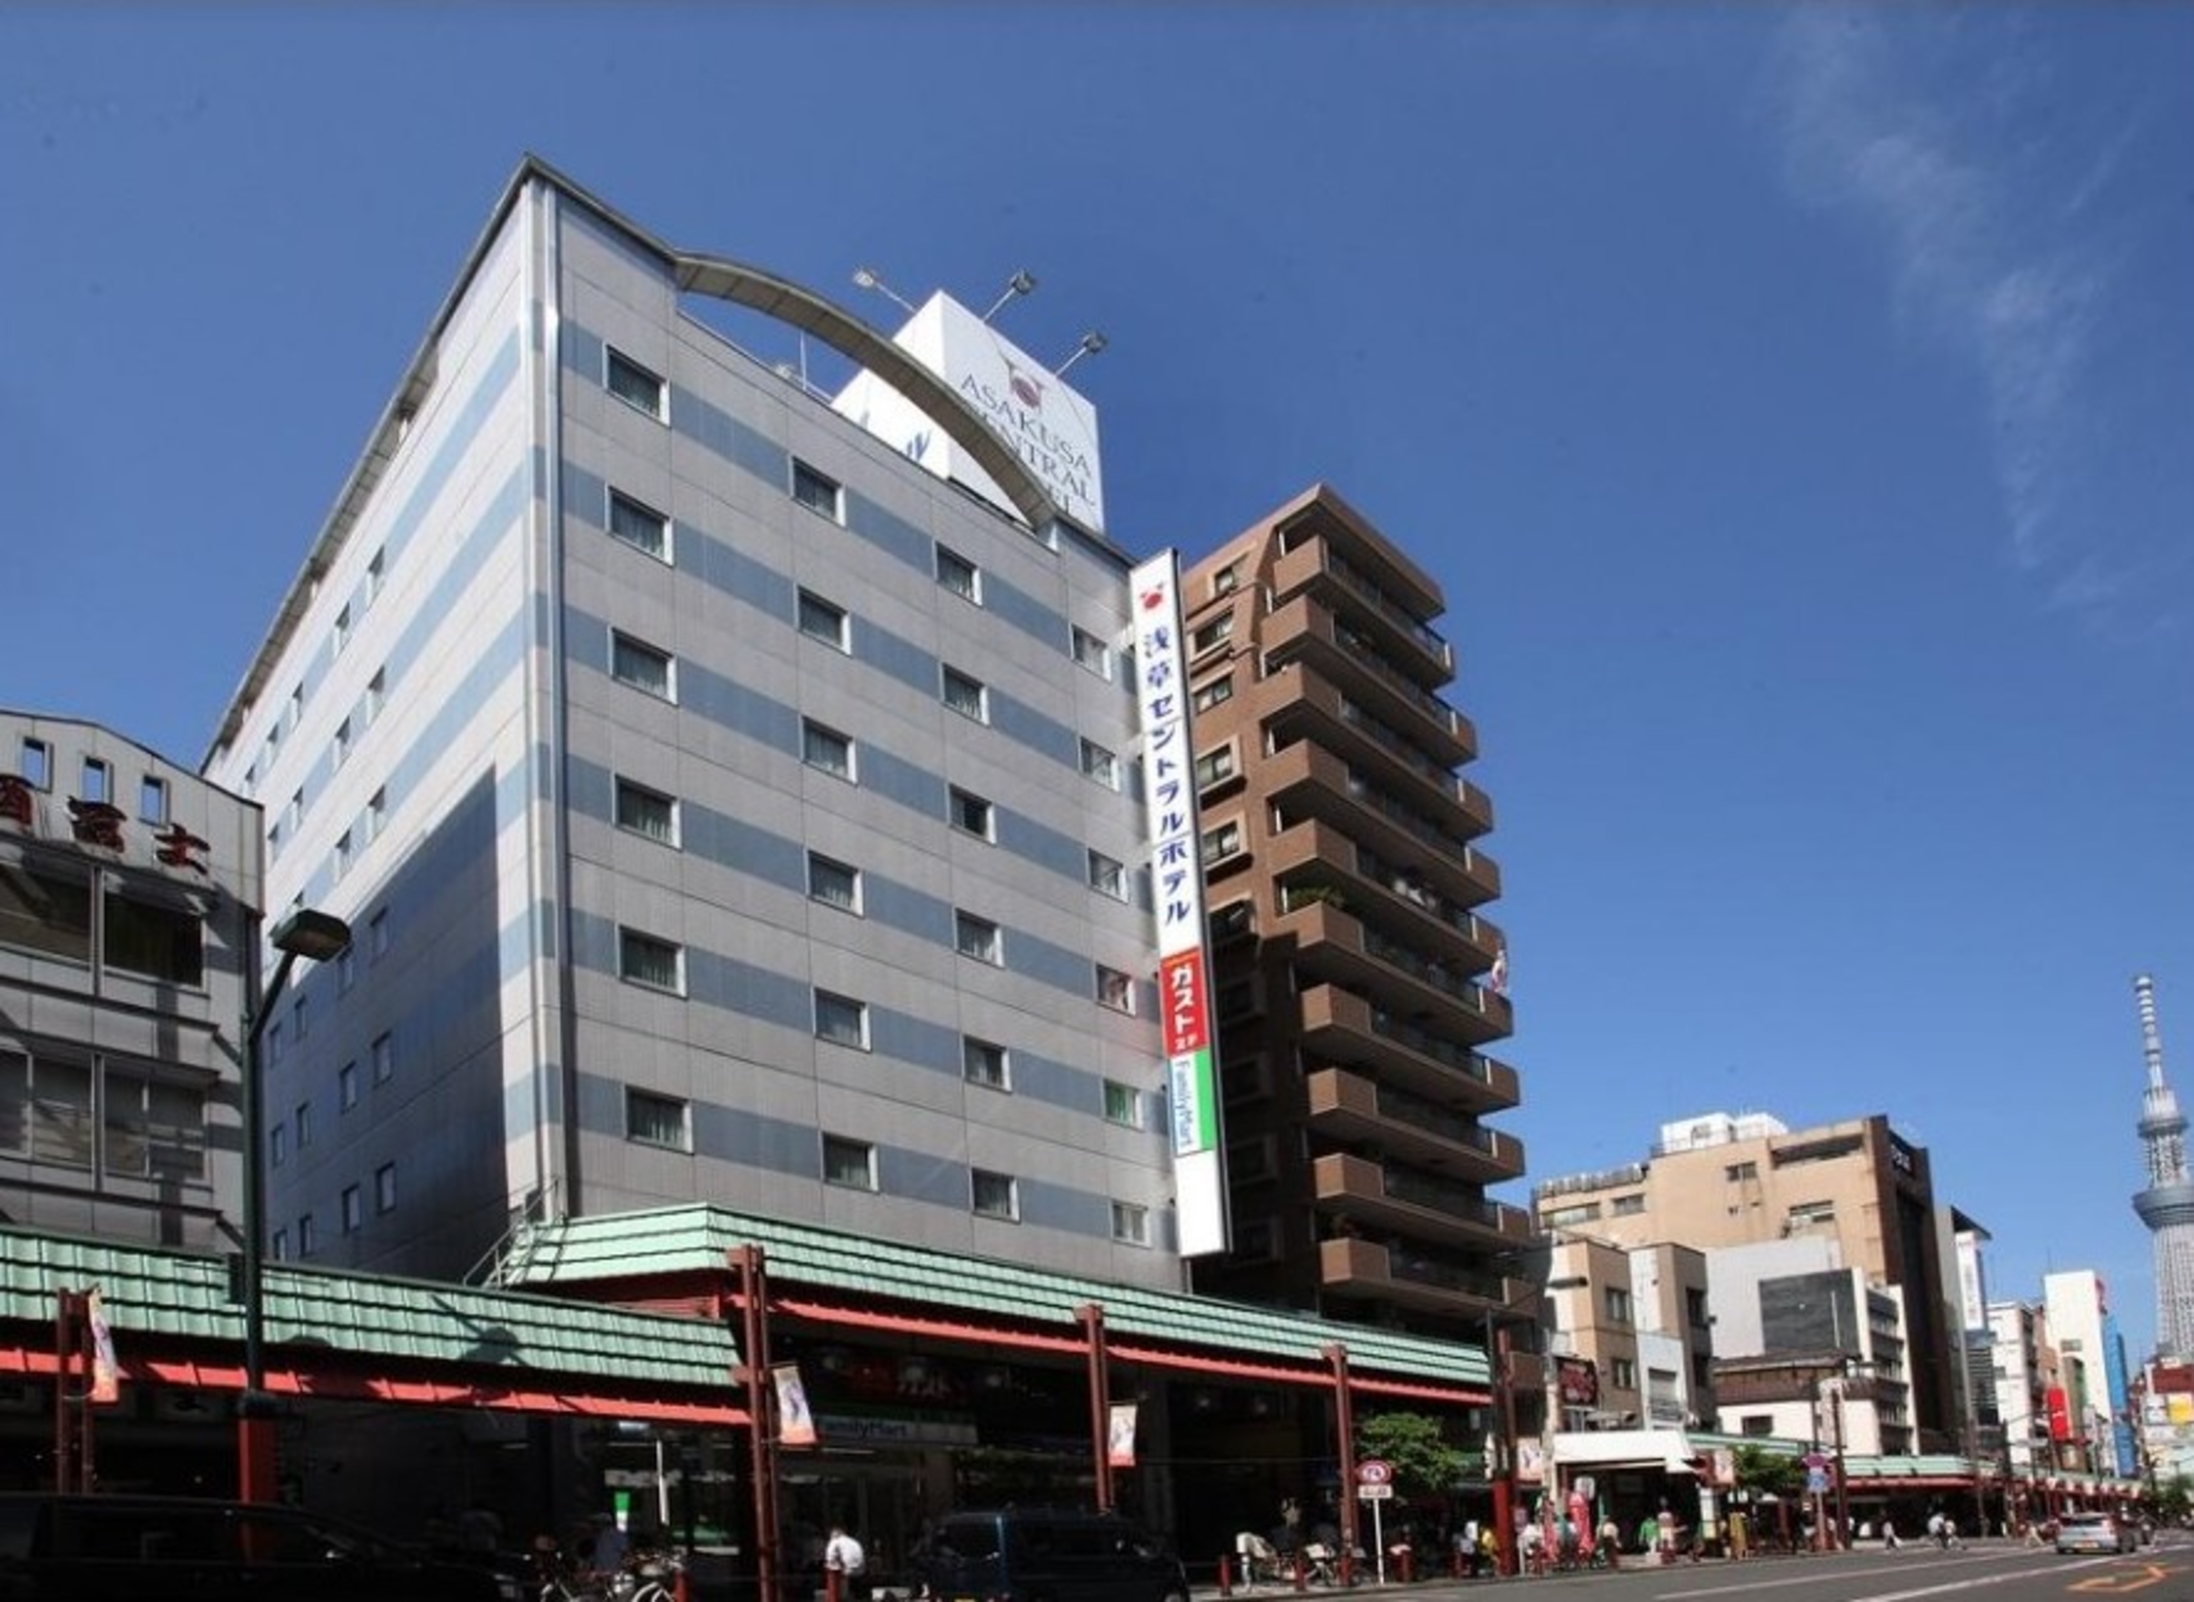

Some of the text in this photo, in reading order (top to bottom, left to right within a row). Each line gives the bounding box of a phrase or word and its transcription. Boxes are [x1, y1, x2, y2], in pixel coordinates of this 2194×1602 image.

[961, 373, 1092, 478] ASAKUSA
[980, 412, 1096, 507] NTRAL
[1143, 626, 1191, 924] 浅草セントラルホテル
[1171, 962, 1196, 1035] ガスト
[1175, 1060, 1194, 1147] FamilyMart
